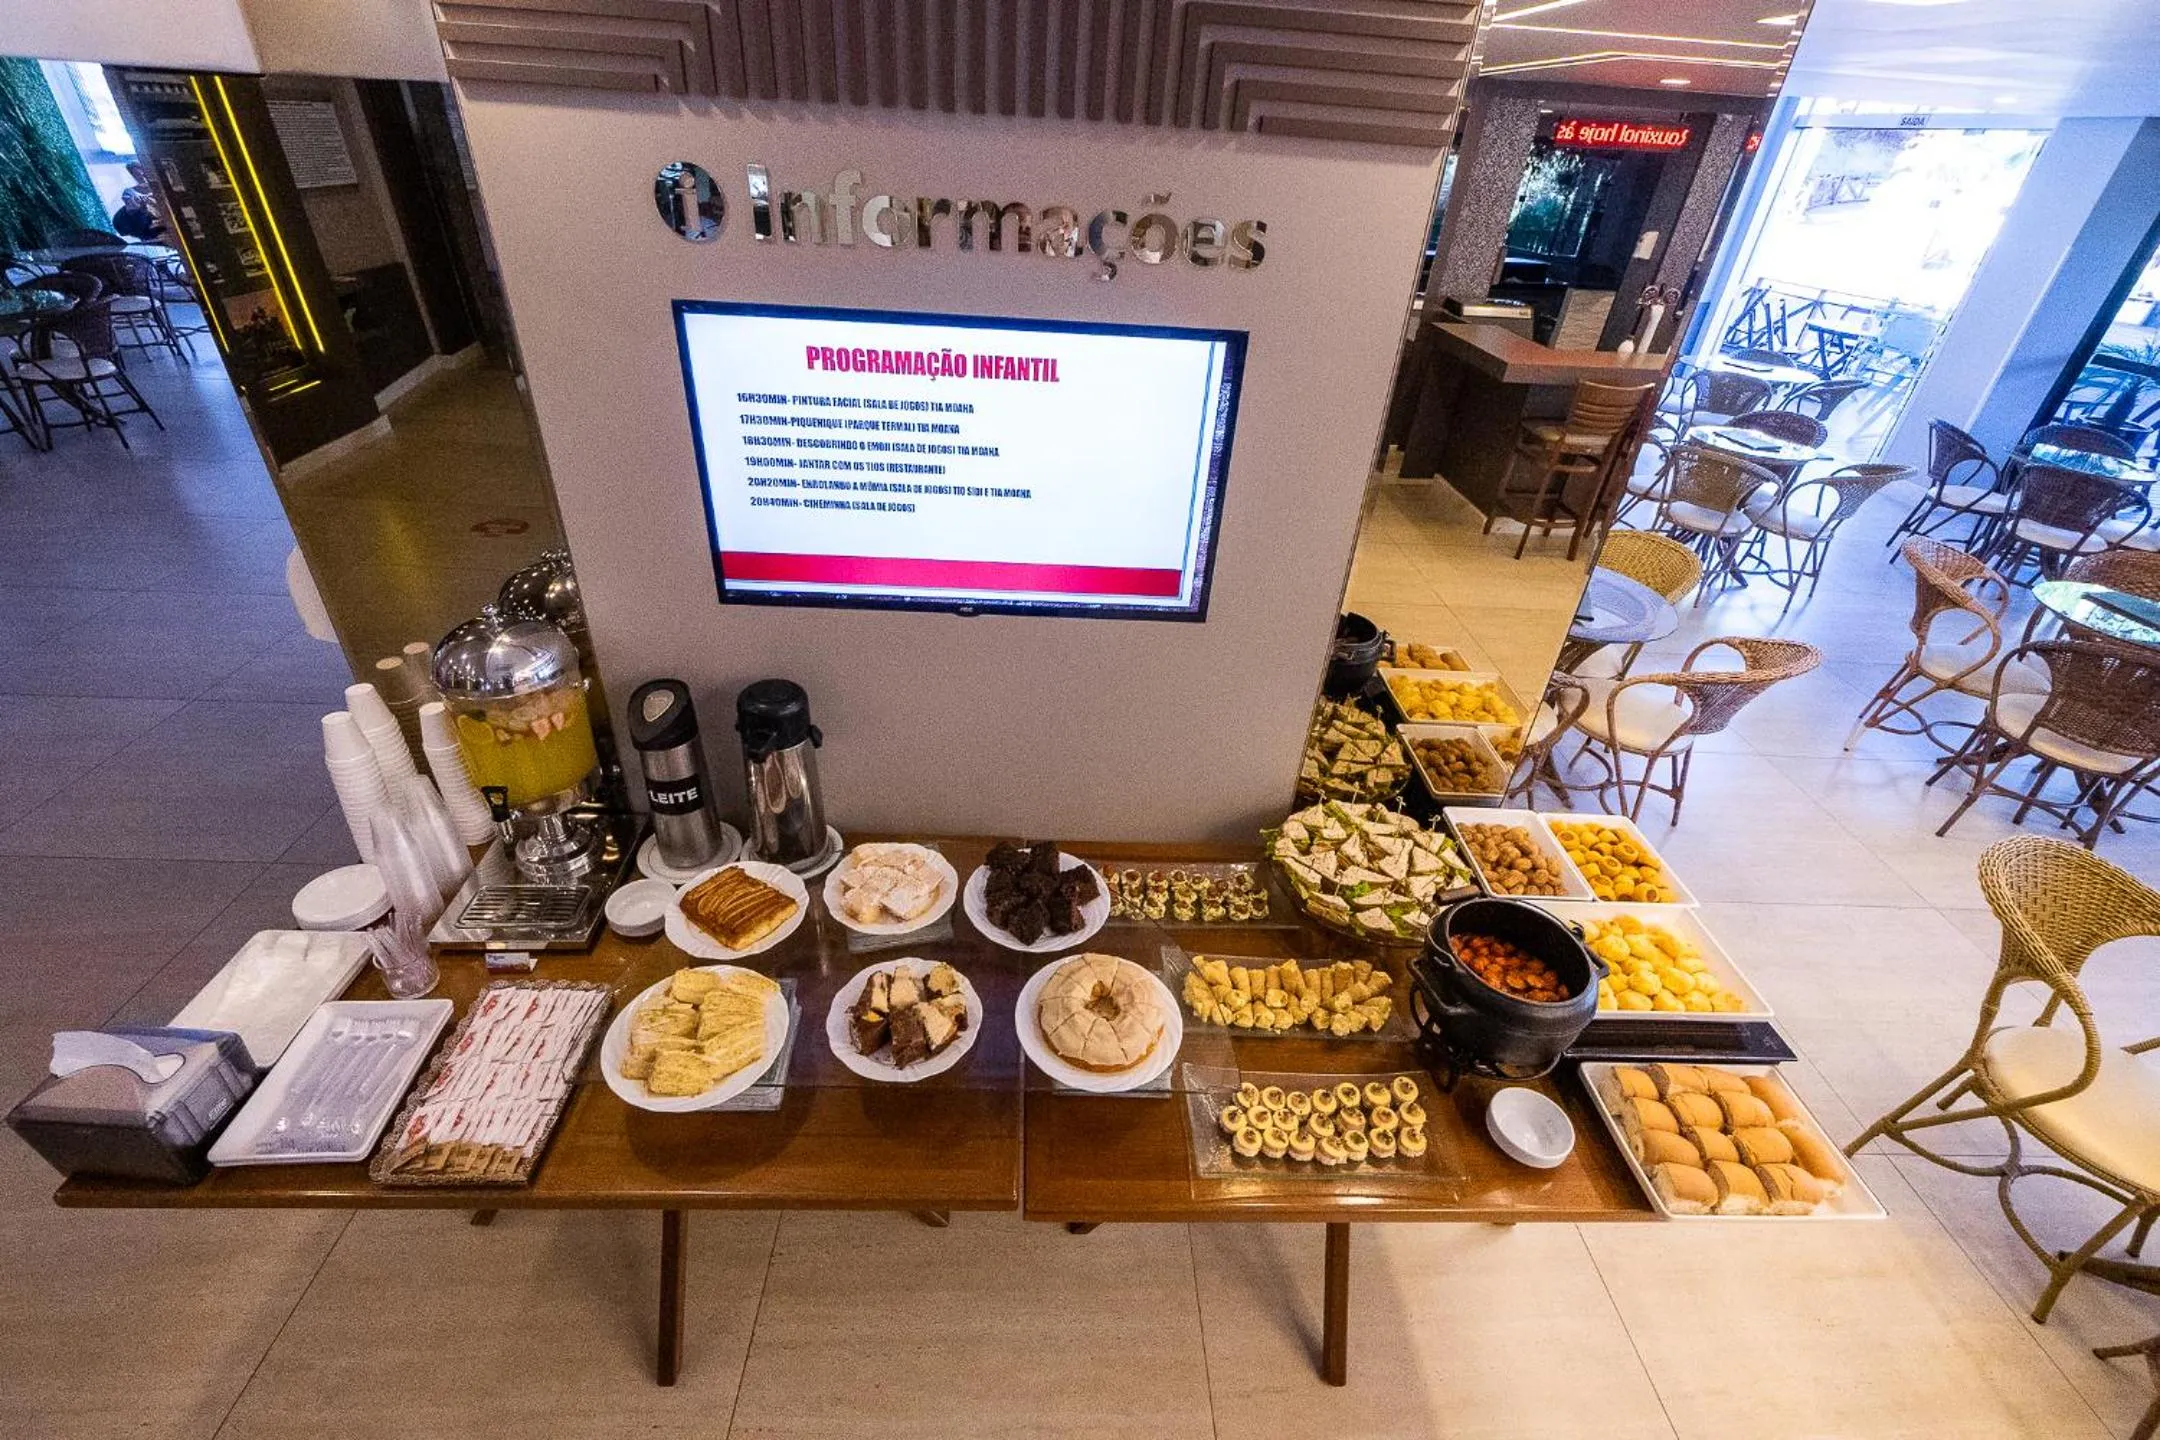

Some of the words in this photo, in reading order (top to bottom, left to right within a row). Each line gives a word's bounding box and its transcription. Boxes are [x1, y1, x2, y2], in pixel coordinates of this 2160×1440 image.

[746, 162, 1269, 281] Informações
[806, 345, 967, 381] PROGRAMAÇÃO
[973, 354, 1060, 382] INFANTIL
[792, 396, 831, 407] PINTURA
[832, 397, 862, 408] FACIAL
[864, 398, 887, 410] (SALA
[888, 400, 898, 410] DE
[901, 400, 929, 412] JOGOS)
[930, 402, 944, 412] TIA
[945, 402, 974, 414] MOANA
[917, 422, 930, 432] TIA
[932, 423, 960, 434] MOANA
[796, 438, 858, 450] DESCOBRINDO
[859, 441, 866, 450] O
[892, 442, 915, 453] (SALA
[916, 444, 926, 454] DE
[928, 444, 956, 455] JOGOS)
[958, 445, 970, 456] TIA
[971, 446, 1000, 457] MOANA
[798, 458, 831, 470] JANTAR
[832, 460, 852, 470] COM
[853, 461, 865, 472] OS
[866, 462, 885, 472] TIOS
[886, 462, 946, 474] (RESTAURANTE)
[802, 480, 852, 491] ENROLANDO
[852, 482, 859, 491] A
[913, 484, 922, 494] DE
[953, 486, 966, 496] TIO
[990, 488, 1003, 498] TIA
[1004, 488, 1032, 499] MOANA
[803, 499, 851, 510] CINEMINHA
[876, 502, 887, 512] DE
[888, 502, 916, 513] JOGOS)
[650, 787, 699, 804] LEITE
